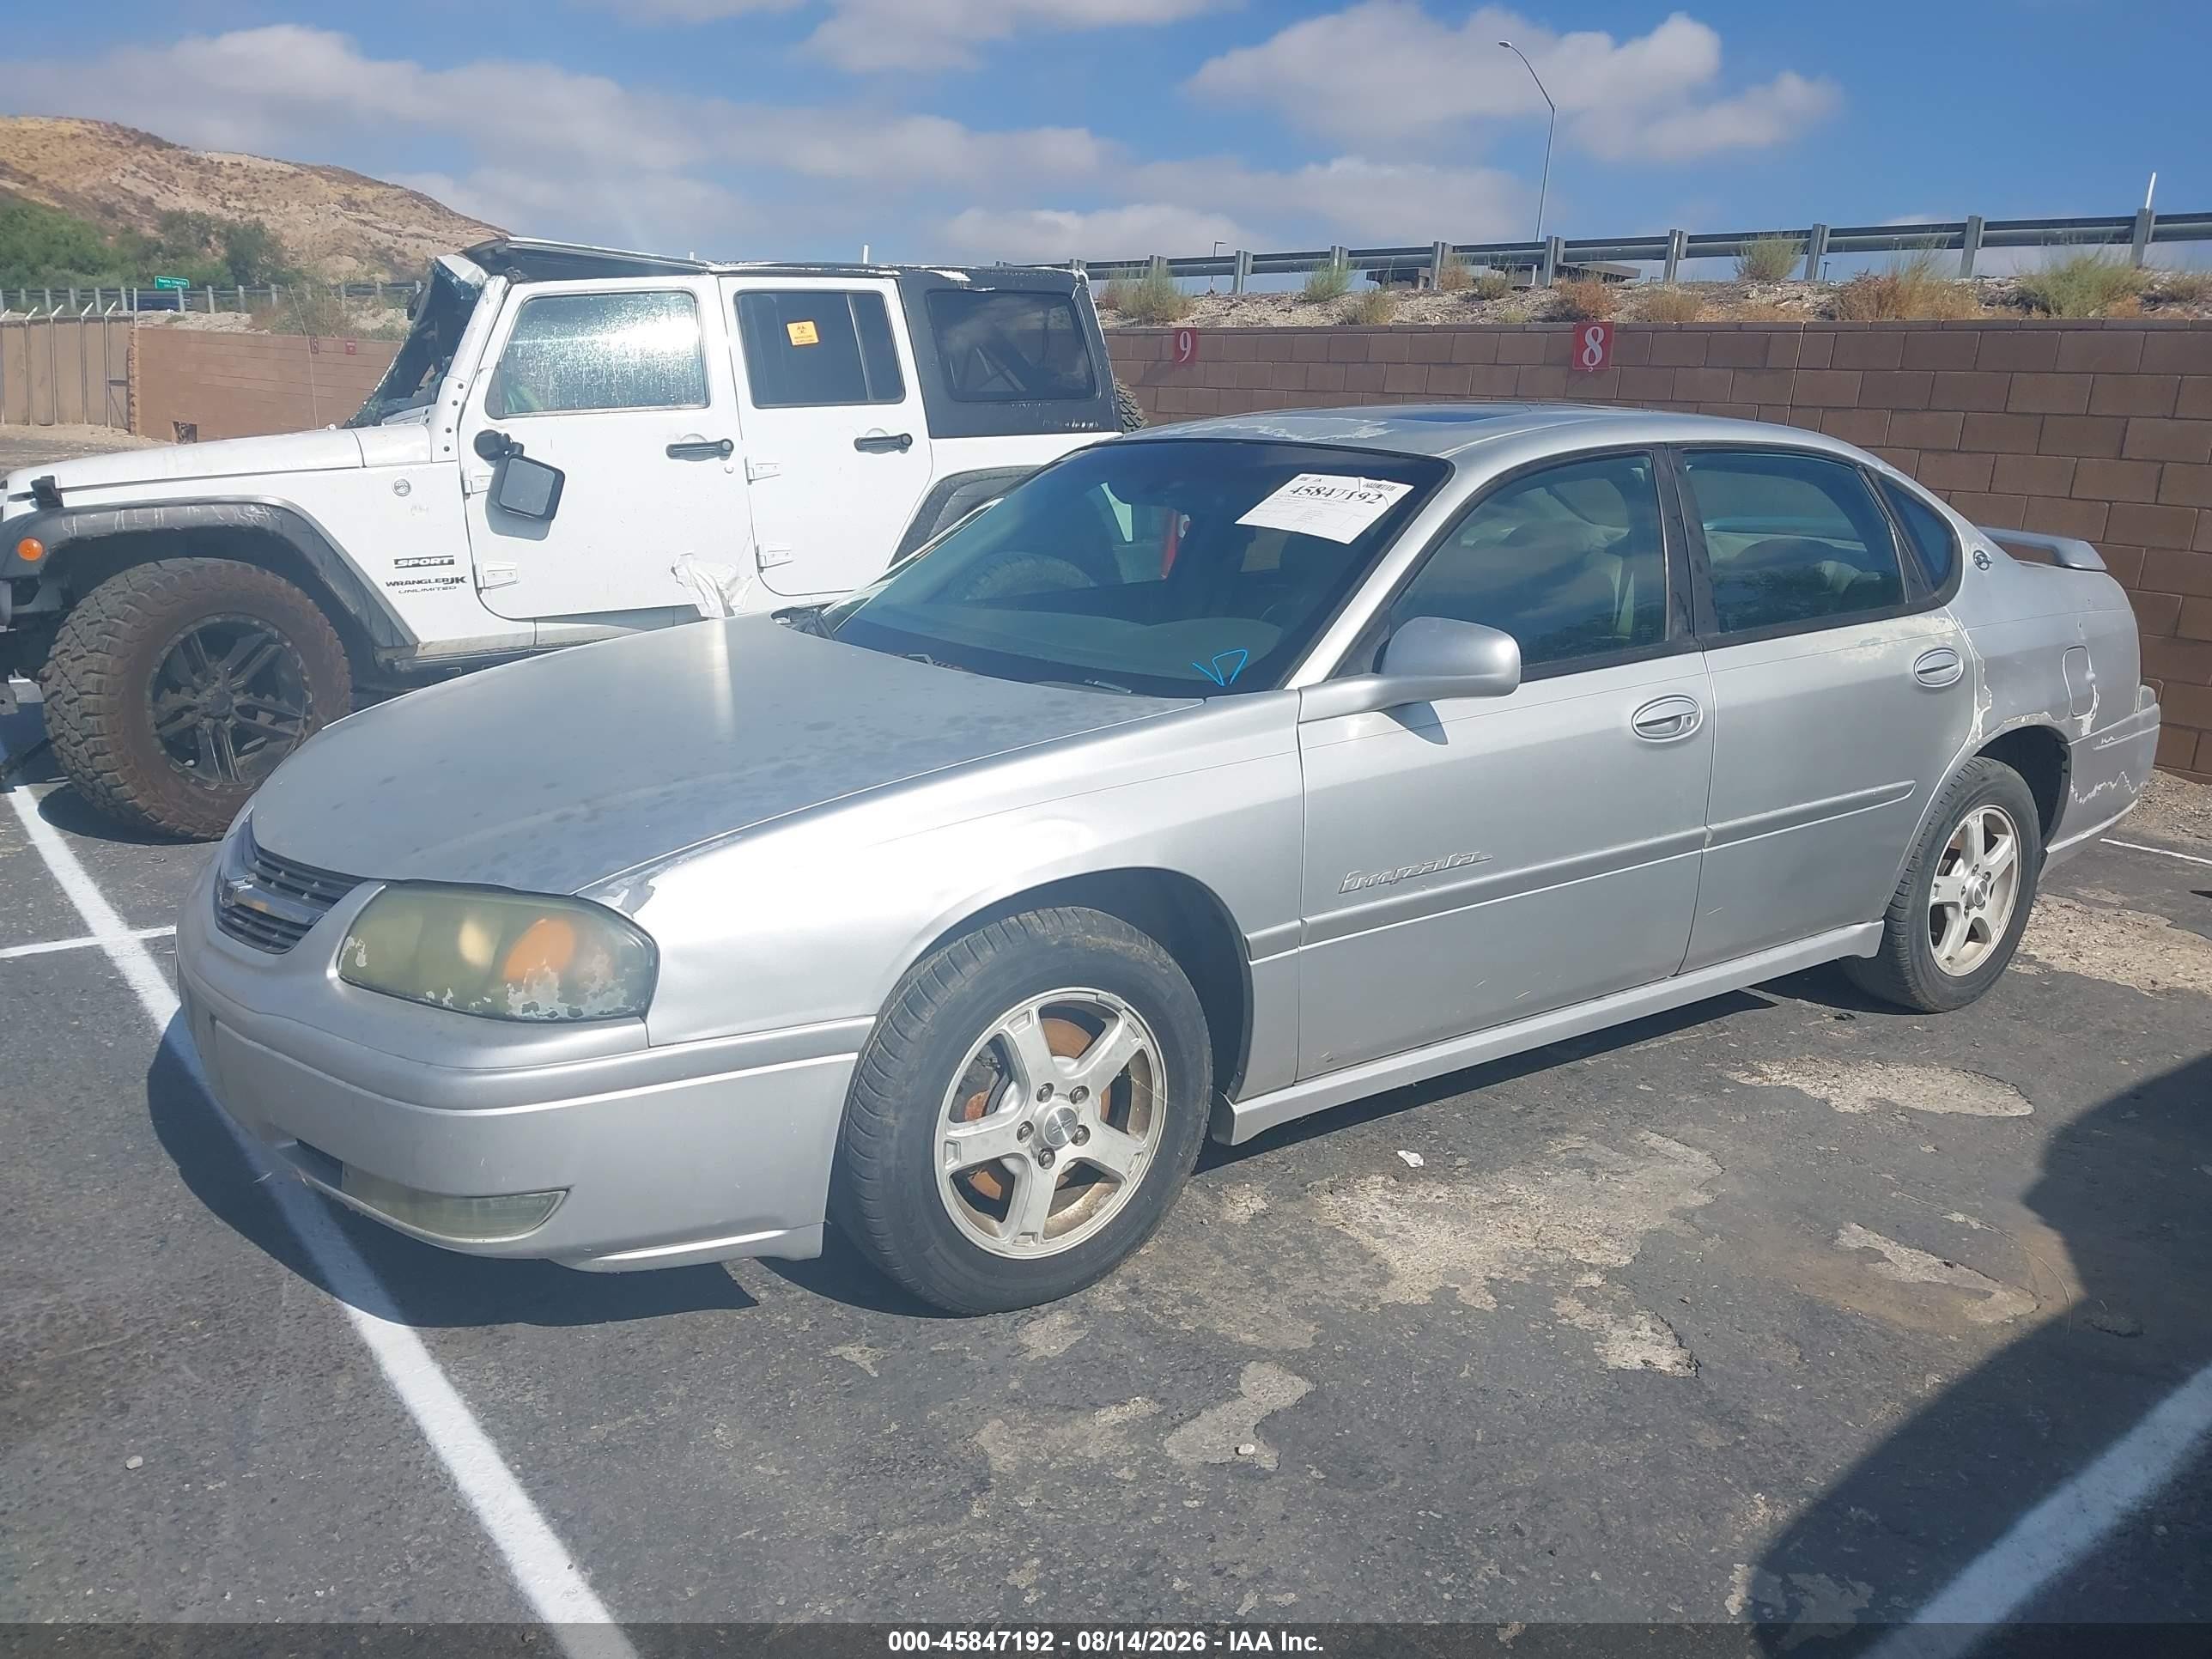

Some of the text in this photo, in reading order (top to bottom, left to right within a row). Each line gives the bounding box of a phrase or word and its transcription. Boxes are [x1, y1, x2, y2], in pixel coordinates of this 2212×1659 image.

[1178, 331, 1191, 362] 9
[1583, 326, 1604, 366] 8
[1290, 485, 1382, 504] 45847192
[397, 557, 453, 567] SPORT
[398, 586, 457, 594] UNLIMITED
[1338, 851, 1493, 894] Impala
